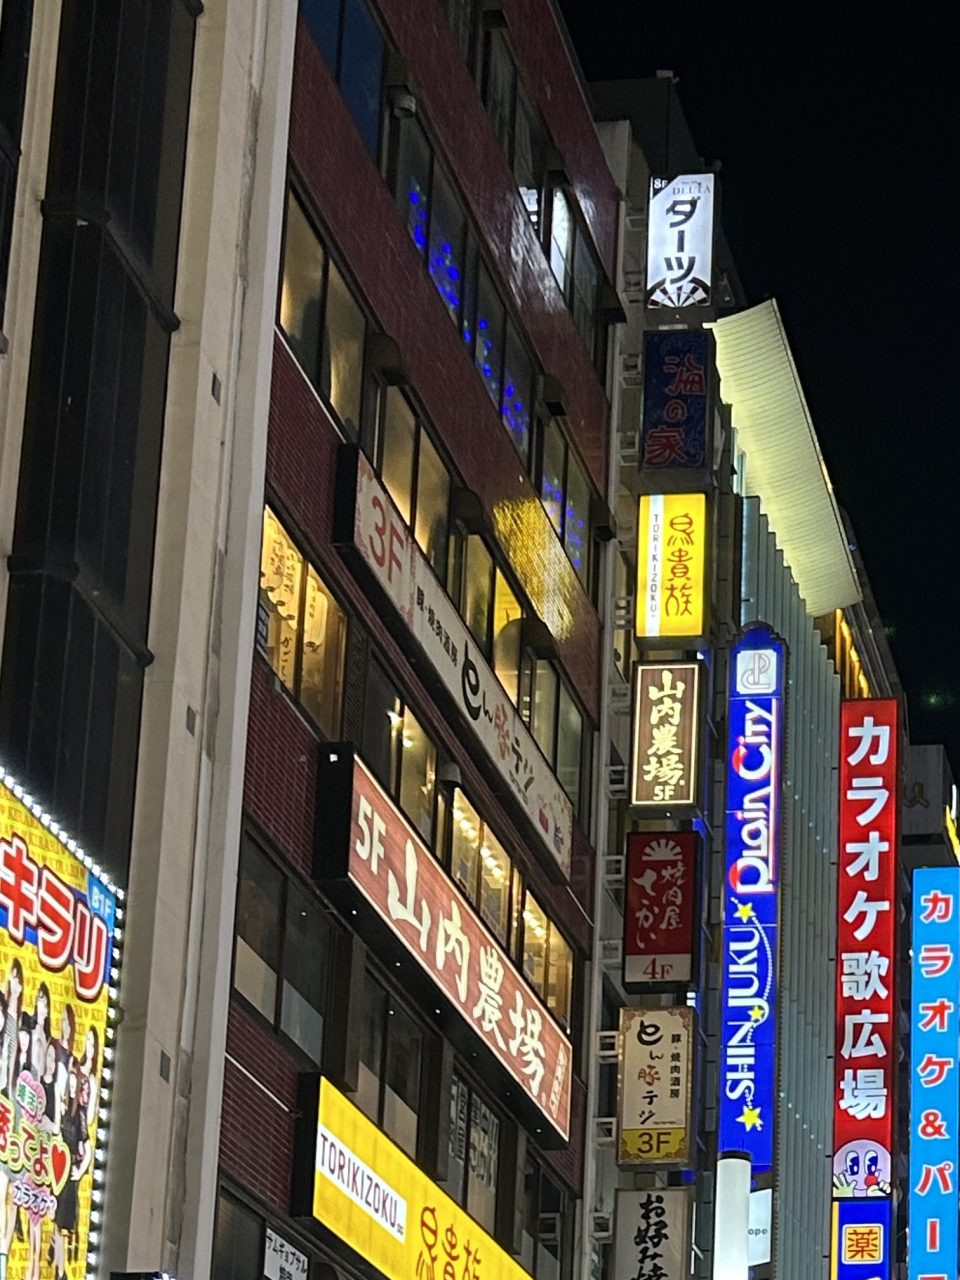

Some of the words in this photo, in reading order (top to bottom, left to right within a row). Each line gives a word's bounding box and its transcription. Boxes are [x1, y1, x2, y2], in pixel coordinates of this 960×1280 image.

[664, 196, 701, 285] ダーツ
[645, 353, 706, 468] 海の家
[369, 499, 403, 584] 3F
[650, 512, 660, 612] TORIKIZOKU
[665, 513, 696, 617] 鳥貴族
[642, 670, 687, 785] 山内農場
[354, 795, 388, 875] 5F
[653, 785, 676, 802] 5F
[661, 861, 687, 930] 焼肉屋
[840, 717, 892, 1119] カラオケ歌広場
[387, 837, 546, 1098] 山内農場
[643, 956, 674, 981] 4F
[726, 926, 770, 1100] SHINJUKU
[637, 1019, 664, 1125] とん豚テジ
[319, 1133, 399, 1230] TORIKIZOKU
[637, 1132, 672, 1154] 3F
[846, 1229, 881, 1261] 薬
